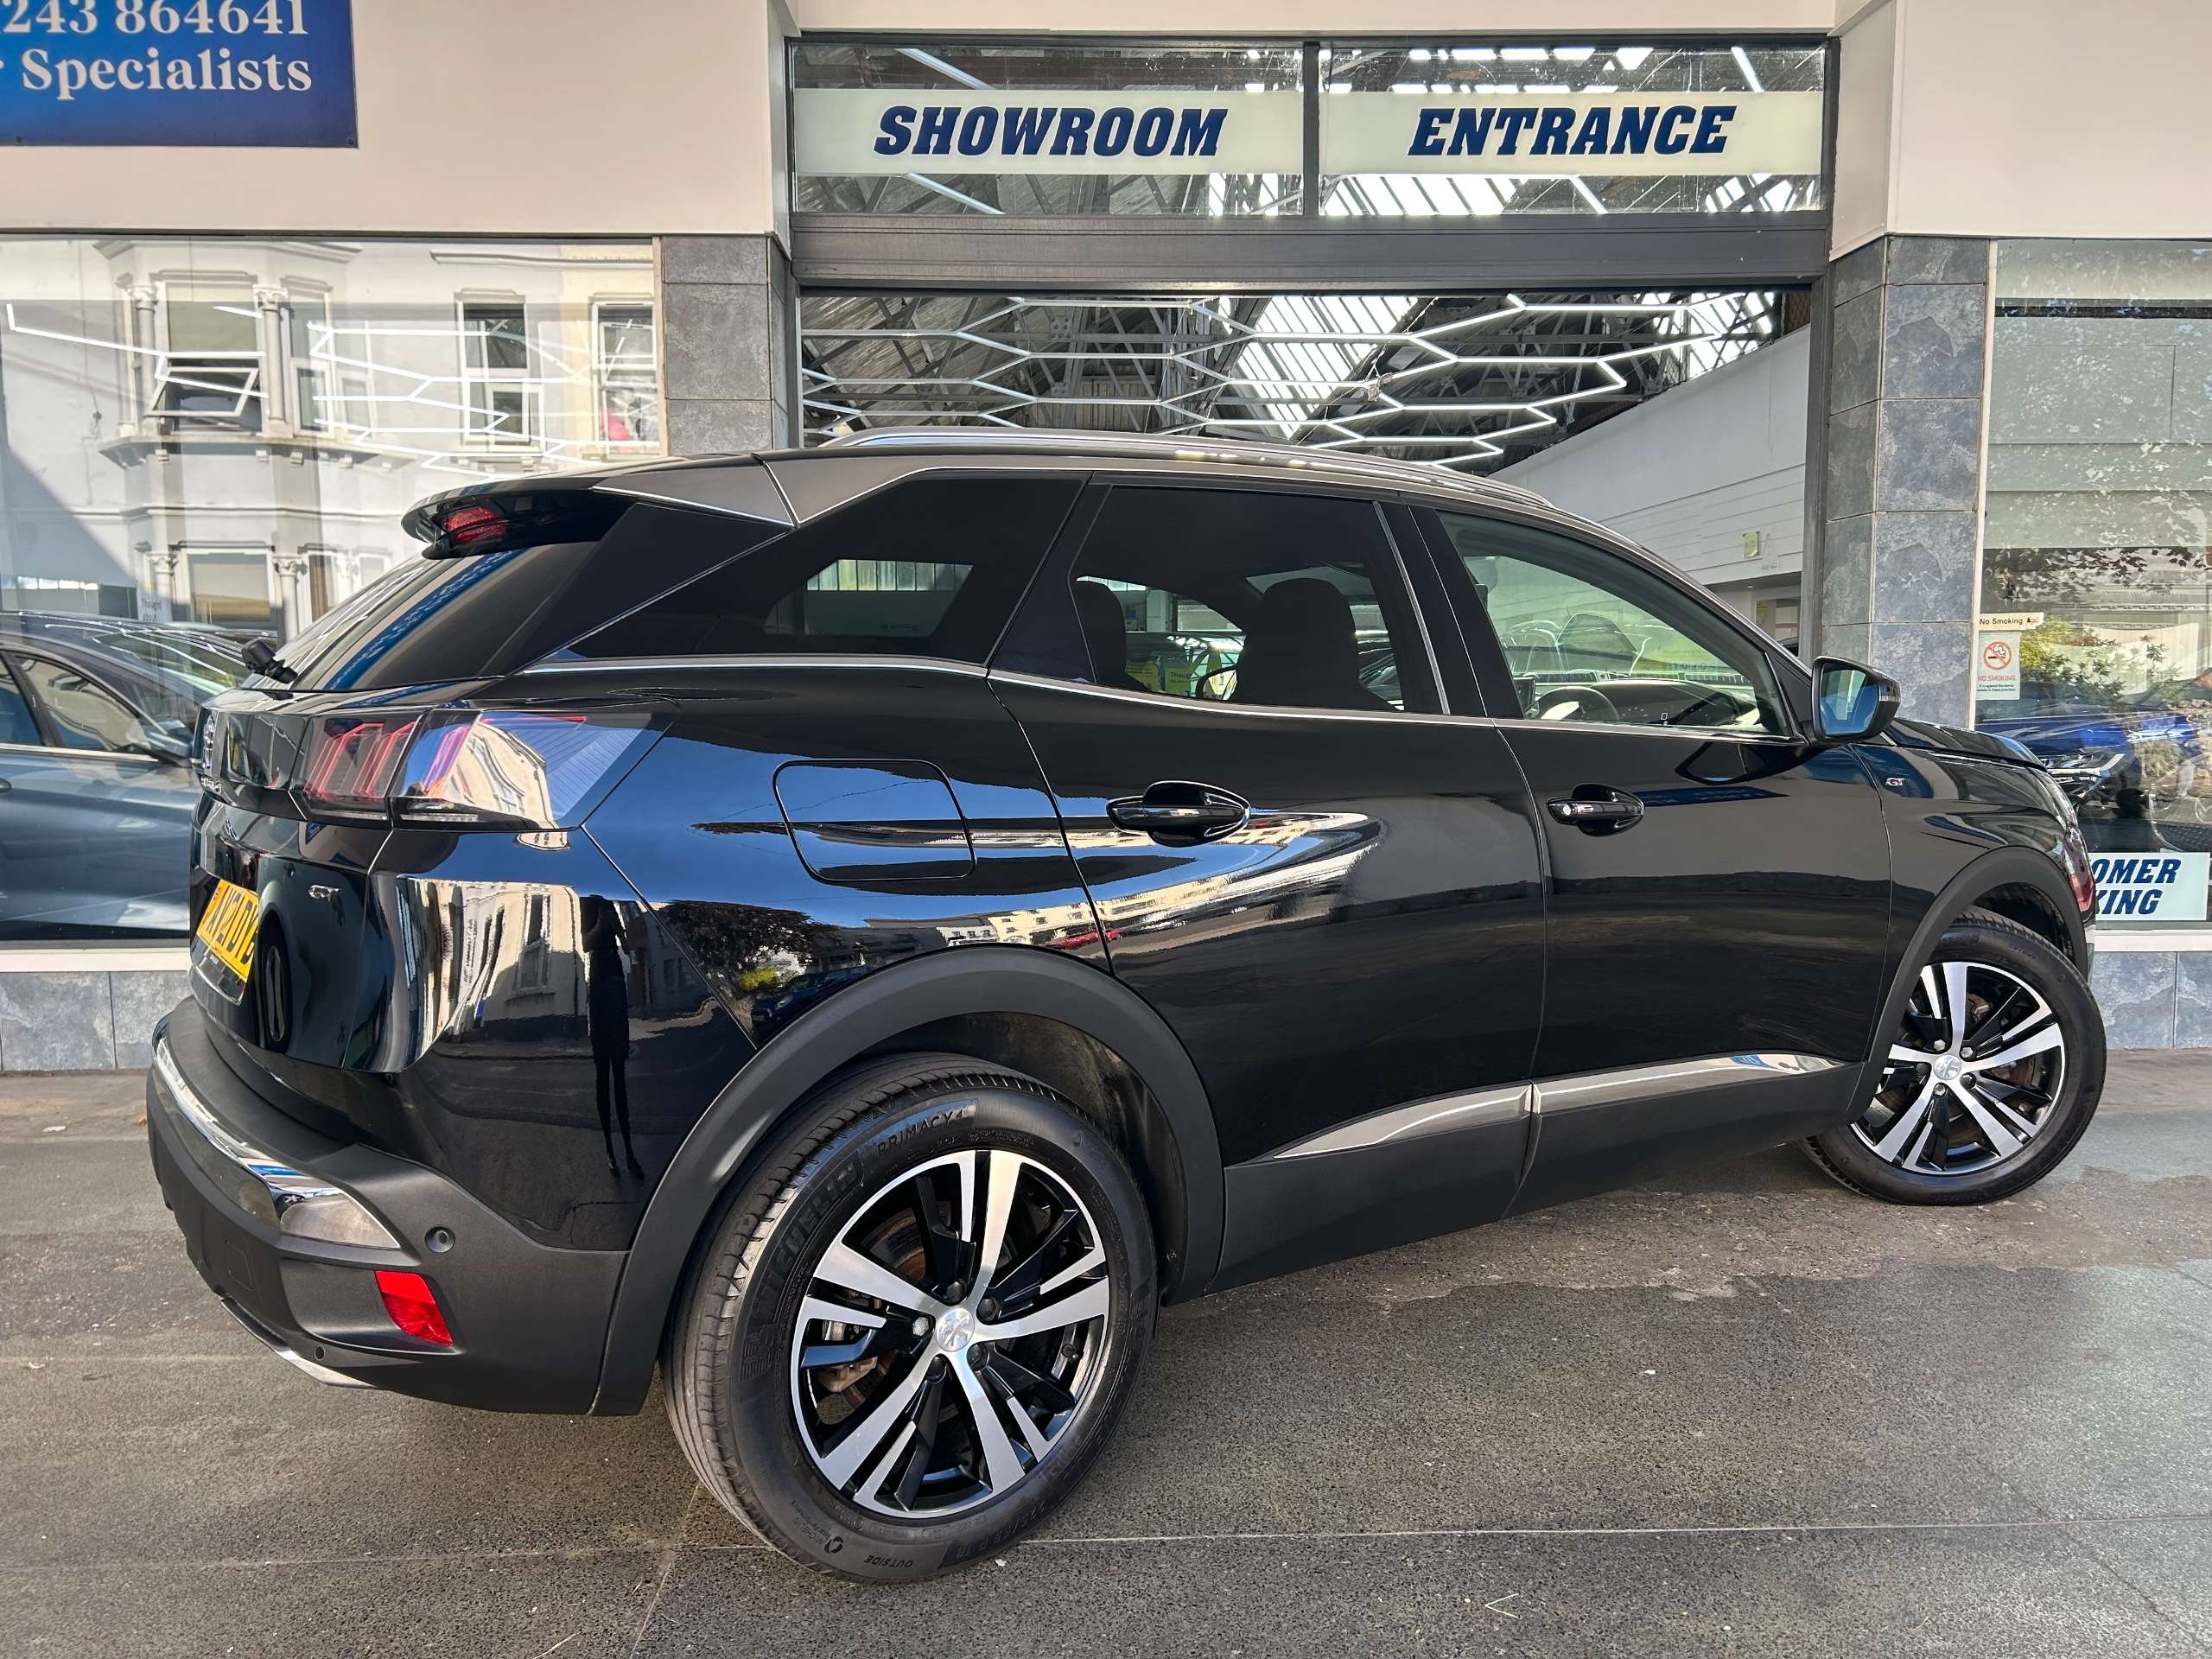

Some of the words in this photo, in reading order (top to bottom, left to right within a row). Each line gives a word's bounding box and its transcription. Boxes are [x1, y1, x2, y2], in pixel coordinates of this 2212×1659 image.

[0, 0, 98, 34] 243
[115, 0, 309, 34] 864641
[22, 47, 312, 100] Specialists
[874, 105, 1229, 156] SHOWROOM
[1408, 105, 1738, 156] ENTRANCE
[2091, 858, 2182, 884] OMER
[876, 1112, 953, 1157] PRIMACY
[863, 1554, 913, 1569] OUTSIDE
